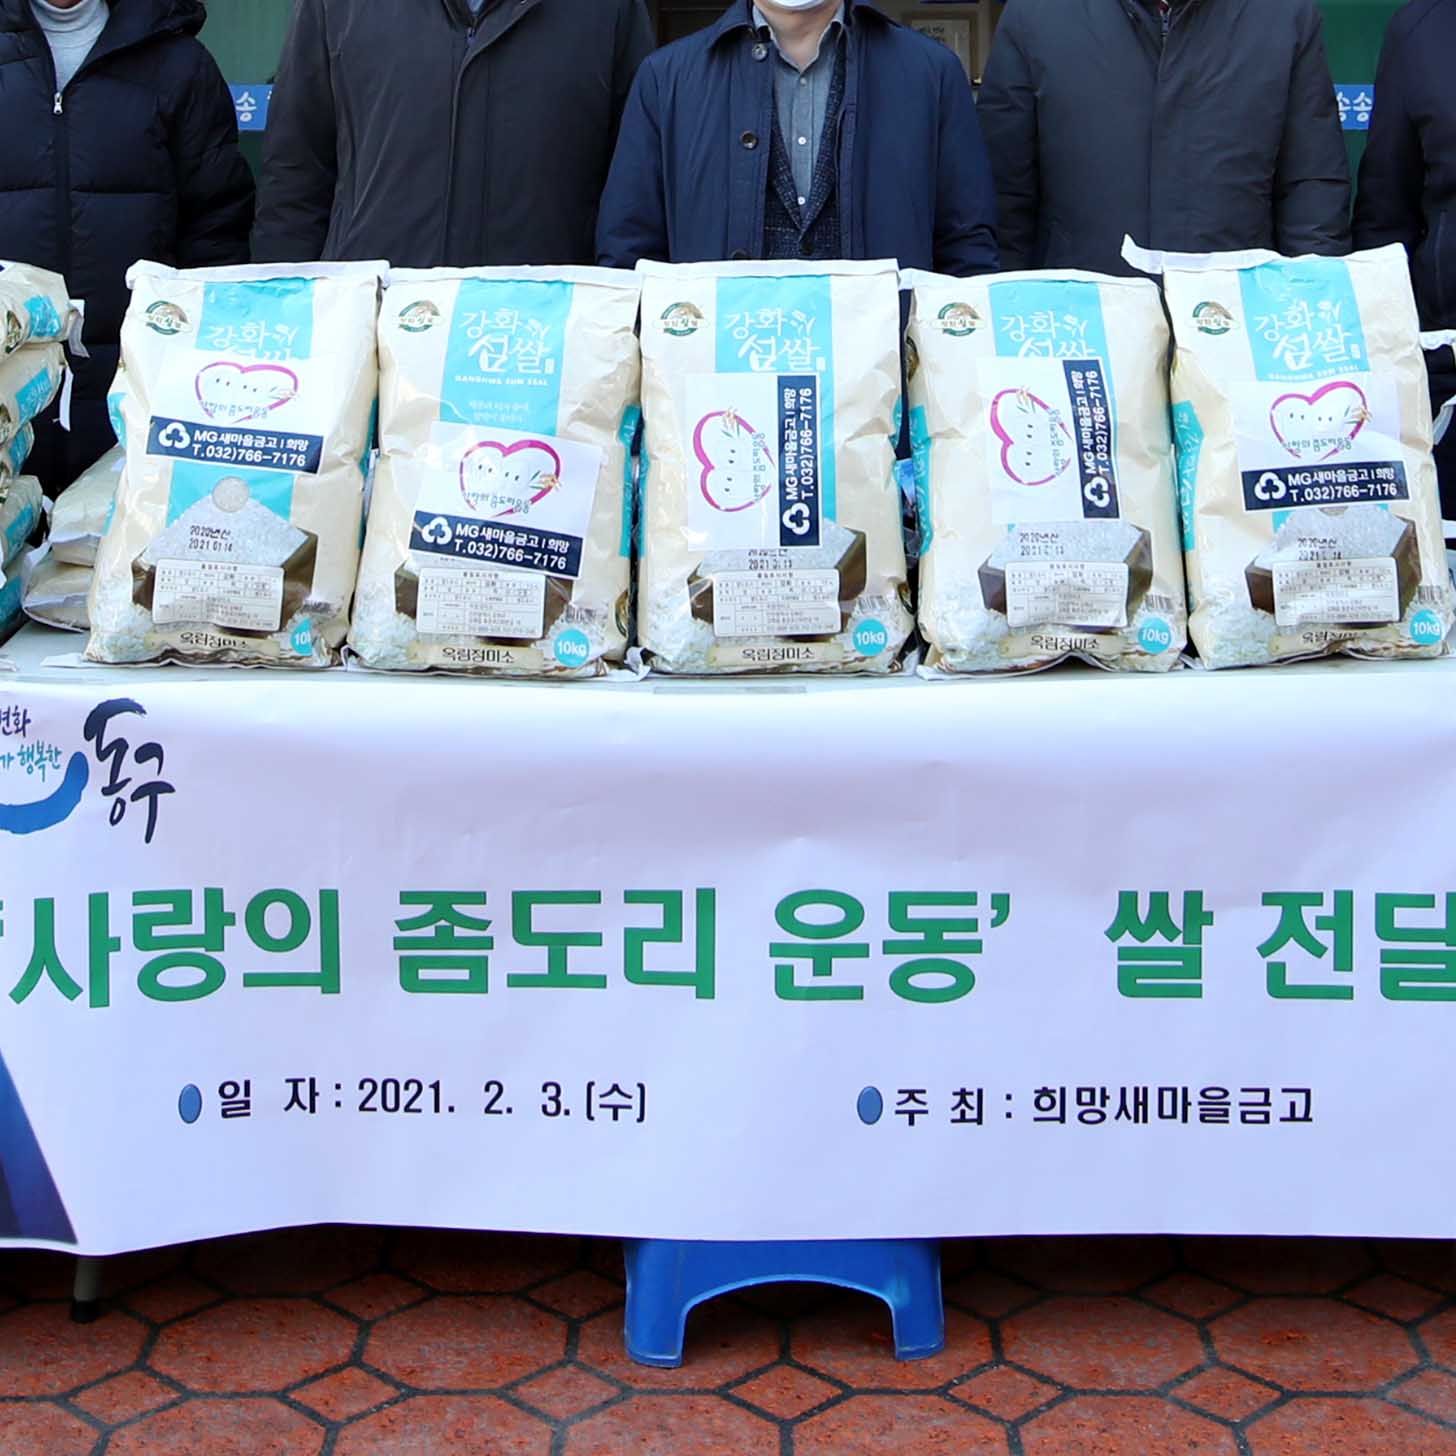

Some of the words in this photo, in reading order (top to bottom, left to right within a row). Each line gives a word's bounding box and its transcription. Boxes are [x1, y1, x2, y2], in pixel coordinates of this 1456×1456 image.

[458, 308, 524, 341] 강화
[725, 308, 788, 341] 강화
[1000, 311, 1062, 342] 강화
[1253, 300, 1315, 342] 강화
[1086, 370, 1110, 474] T.032)766-7176
[192, 444, 307, 467] T.032)766-7176
[799, 387, 814, 500] T.032)766-7176
[1375, 466, 1395, 480] 희망
[1288, 482, 1398, 502] T.032)766-7176
[453, 539, 567, 571] T.032)766-7176
[547, 539, 570, 554] 희망
[855, 630, 885, 648] 10kg
[1141, 625, 1170, 643] 10kg
[1412, 620, 1441, 636] 10kg
[557, 640, 588, 658] 10kg
[16, 740, 62, 783] 행복한
[83, 697, 176, 844] 동구
[392, 887, 716, 1000] 좀도리
[1104, 889, 1214, 1000] 쌀
[1032, 1084, 1315, 1126] 희망새마을금고
